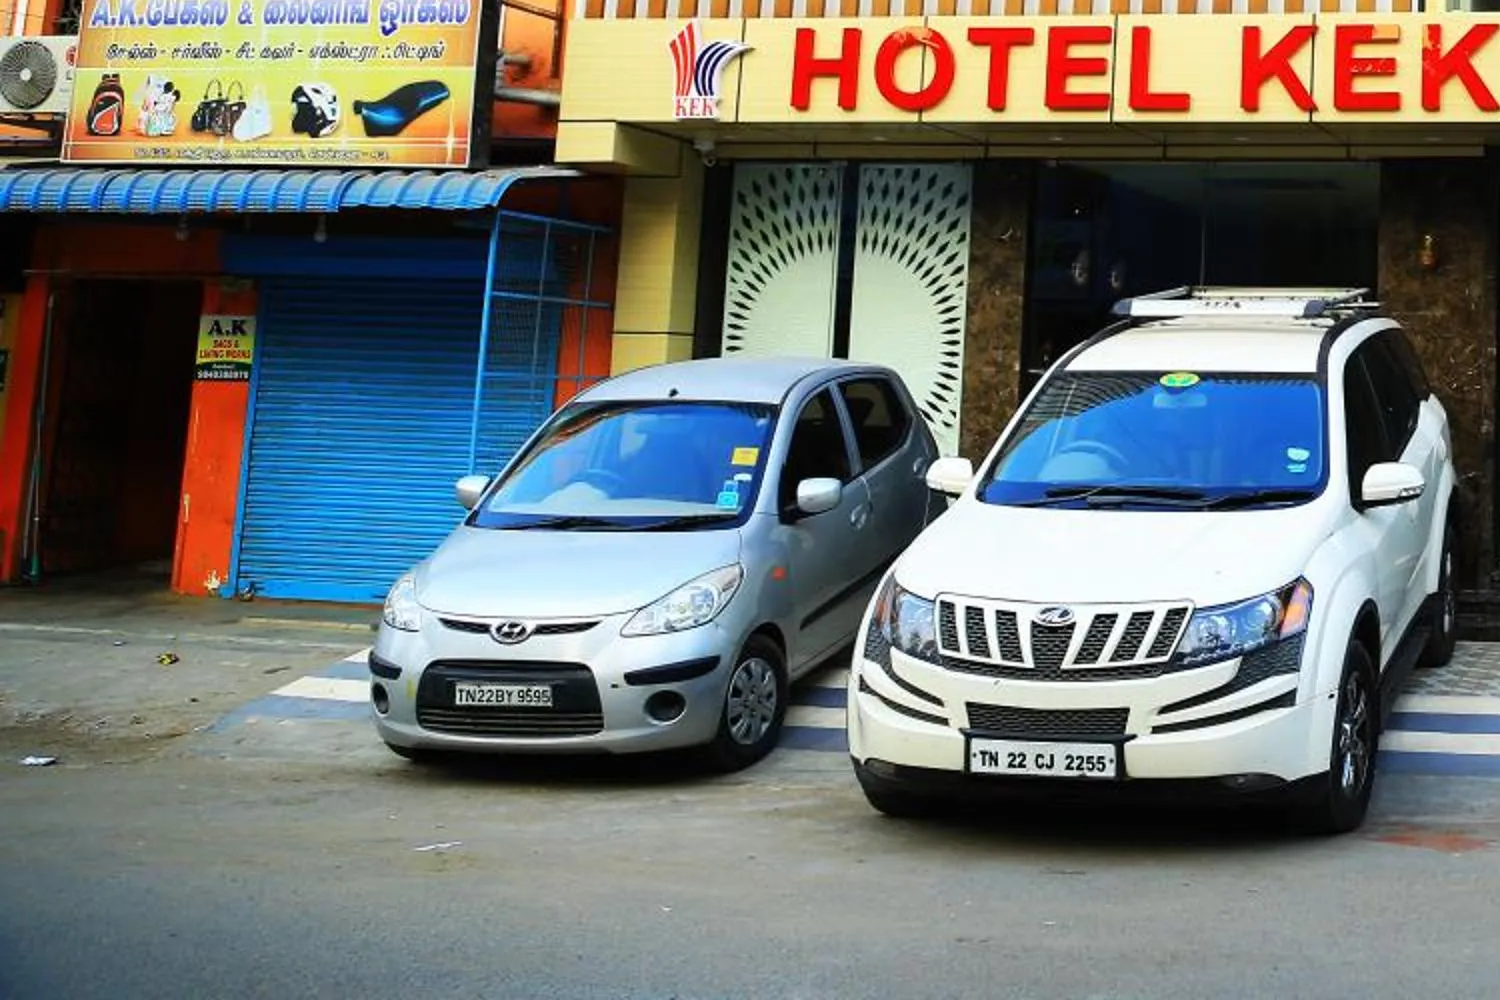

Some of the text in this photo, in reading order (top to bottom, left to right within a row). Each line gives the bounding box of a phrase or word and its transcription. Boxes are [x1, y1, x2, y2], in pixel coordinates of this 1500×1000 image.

[237, 0, 254, 26] &
[791, 24, 1190, 111] HOTEL
[675, 97, 714, 117] KEK
[458, 689, 513, 703] TN22BY
[979, 751, 1107, 772] TN 22 CJ 2255
